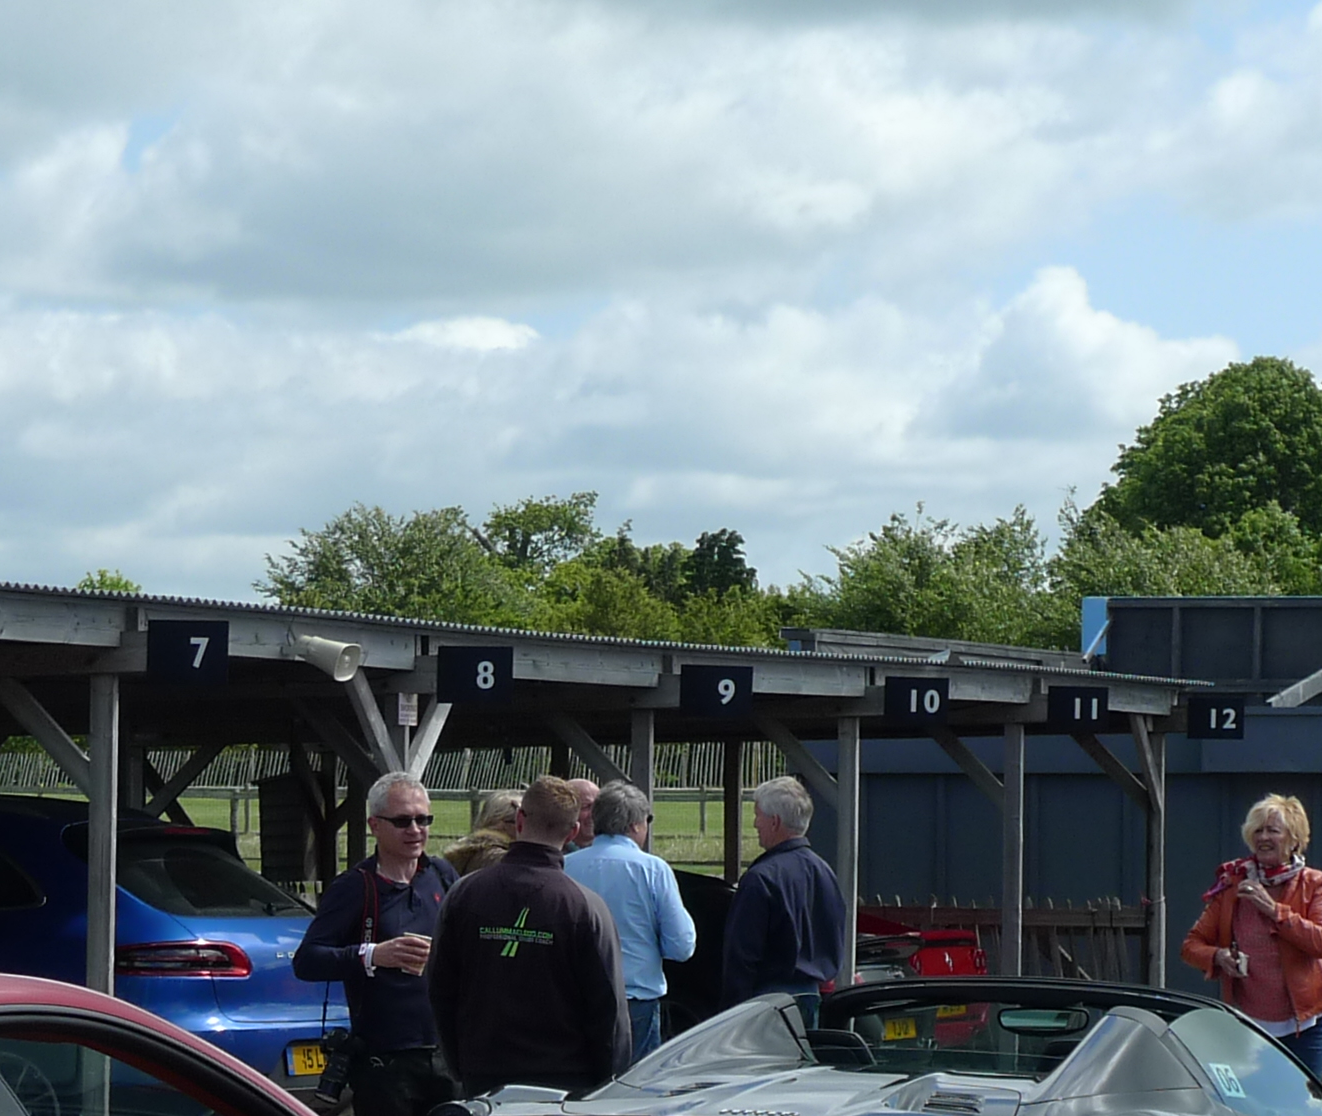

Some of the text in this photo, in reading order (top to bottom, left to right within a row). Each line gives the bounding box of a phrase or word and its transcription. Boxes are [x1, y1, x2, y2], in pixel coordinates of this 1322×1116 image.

[189, 637, 210, 669] 7
[476, 660, 495, 690] 8
[717, 678, 736, 705] 9
[910, 689, 940, 714] 10
[1074, 697, 1098, 720] 11
[1210, 708, 1237, 730] 12
[1216, 1066, 1240, 1093] 06
